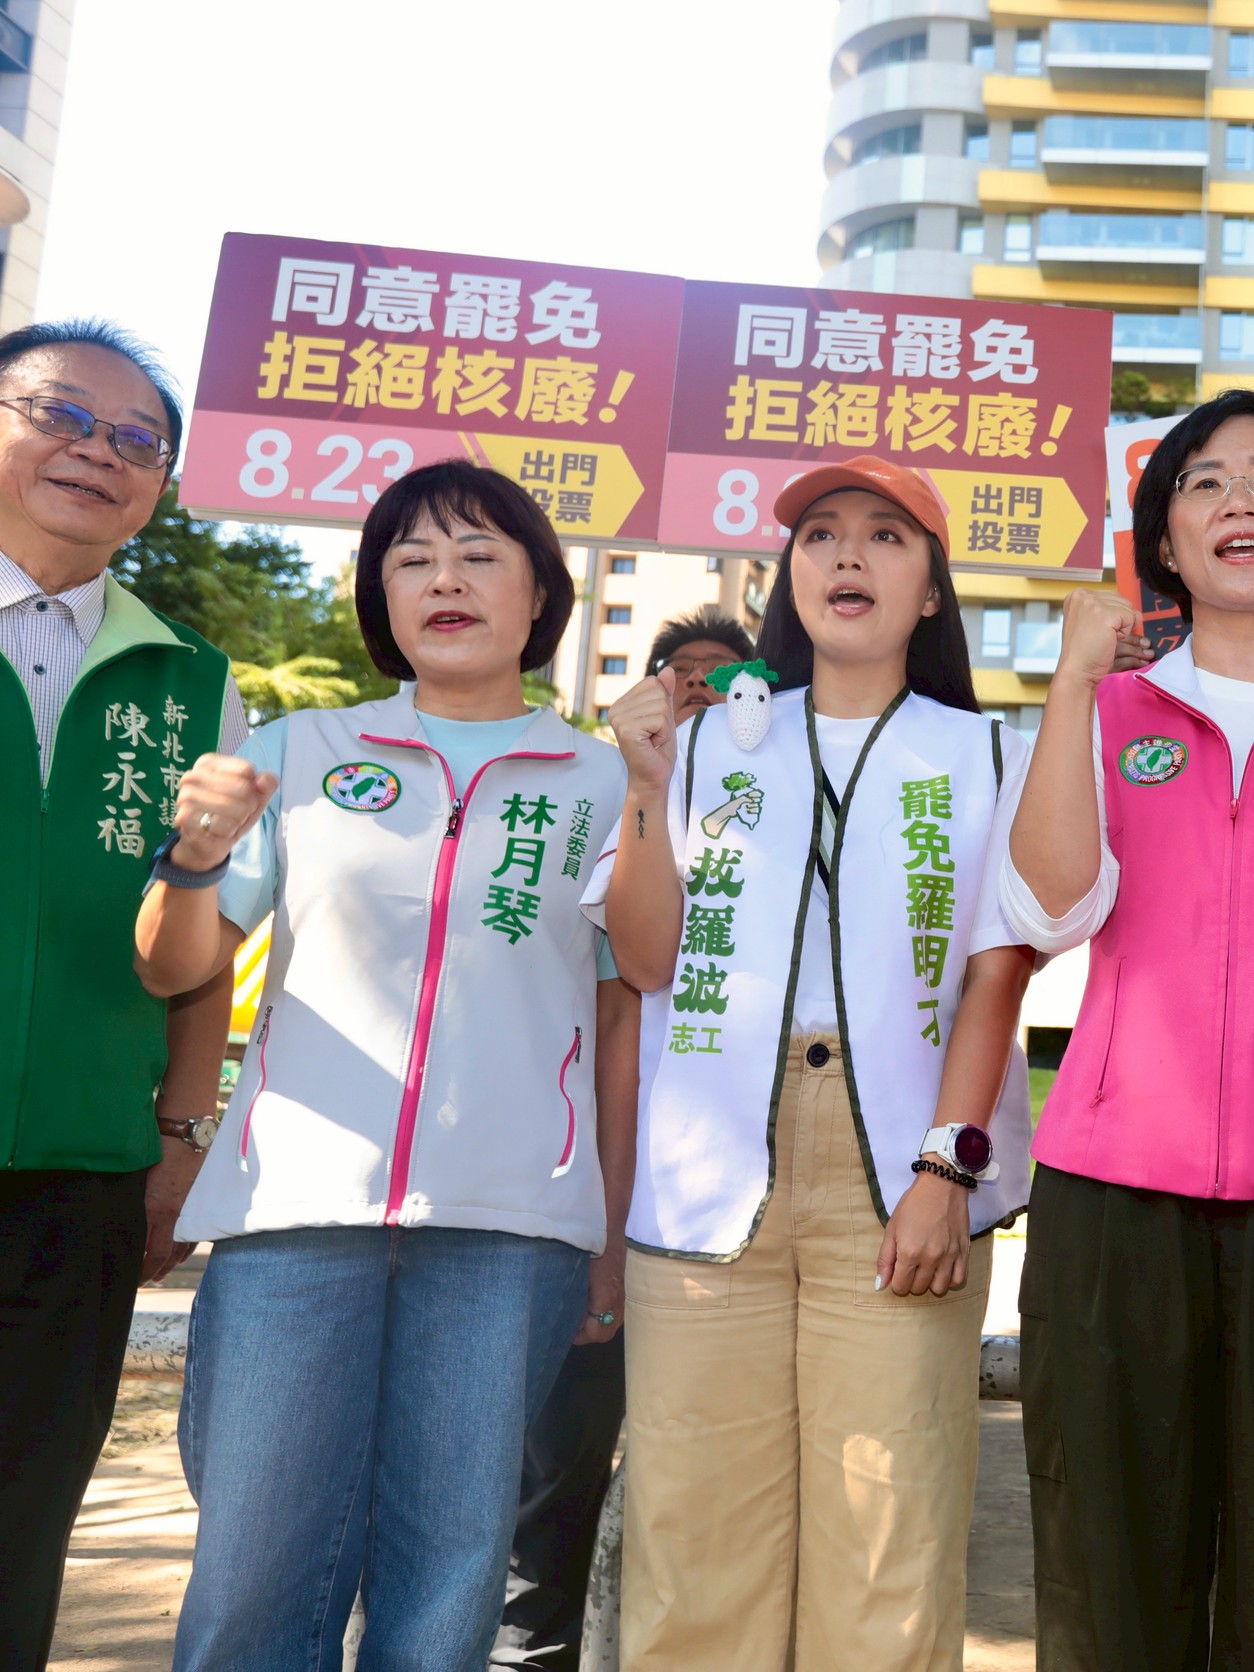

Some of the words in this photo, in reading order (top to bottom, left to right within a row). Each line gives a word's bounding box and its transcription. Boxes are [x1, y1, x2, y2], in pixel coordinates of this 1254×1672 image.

[270, 256, 602, 350] 同意罷免
[733, 303, 1040, 385] 同意罷免
[256, 330, 636, 427] 拒絕核廢!
[724, 374, 1073, 460] 拒絕核廢!
[238, 428, 415, 506] 8.23
[519, 449, 599, 487] 出門
[970, 483, 1043, 519] 出門
[967, 520, 1041, 556] 投票
[97, 702, 157, 859] 陳永福
[481, 793, 559, 946] 林月琴
[560, 798, 595, 881] 立法委員
[898, 773, 956, 1048] 罷免羅明才
[668, 1022, 723, 1054] 志工
